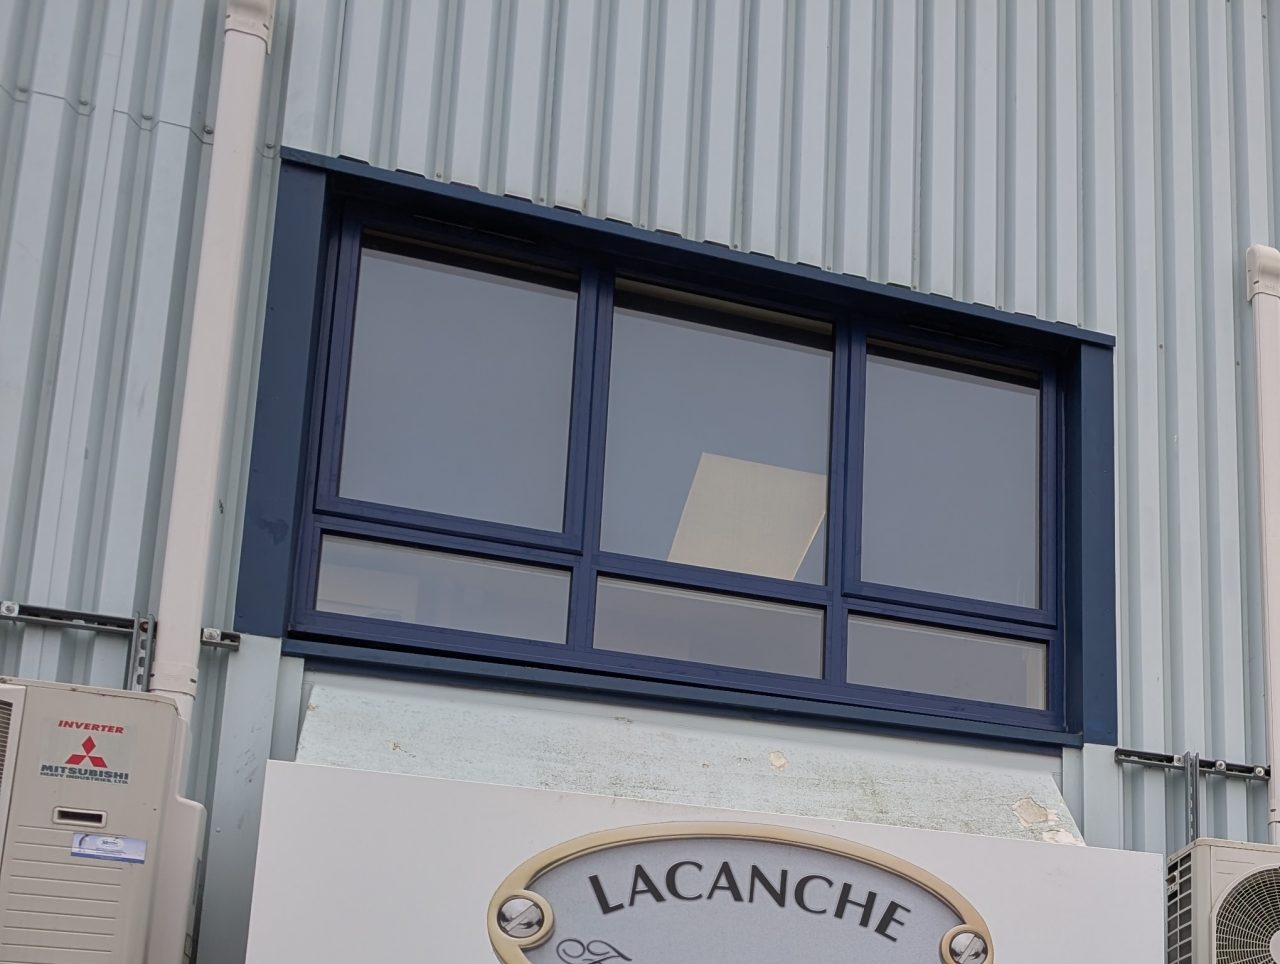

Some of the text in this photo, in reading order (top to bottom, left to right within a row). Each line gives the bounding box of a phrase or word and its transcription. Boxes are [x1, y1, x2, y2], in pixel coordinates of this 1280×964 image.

[58, 720, 124, 734] INVERTER
[40, 764, 129, 780] MITSUBISHI
[588, 860, 912, 942] LACANCHE
